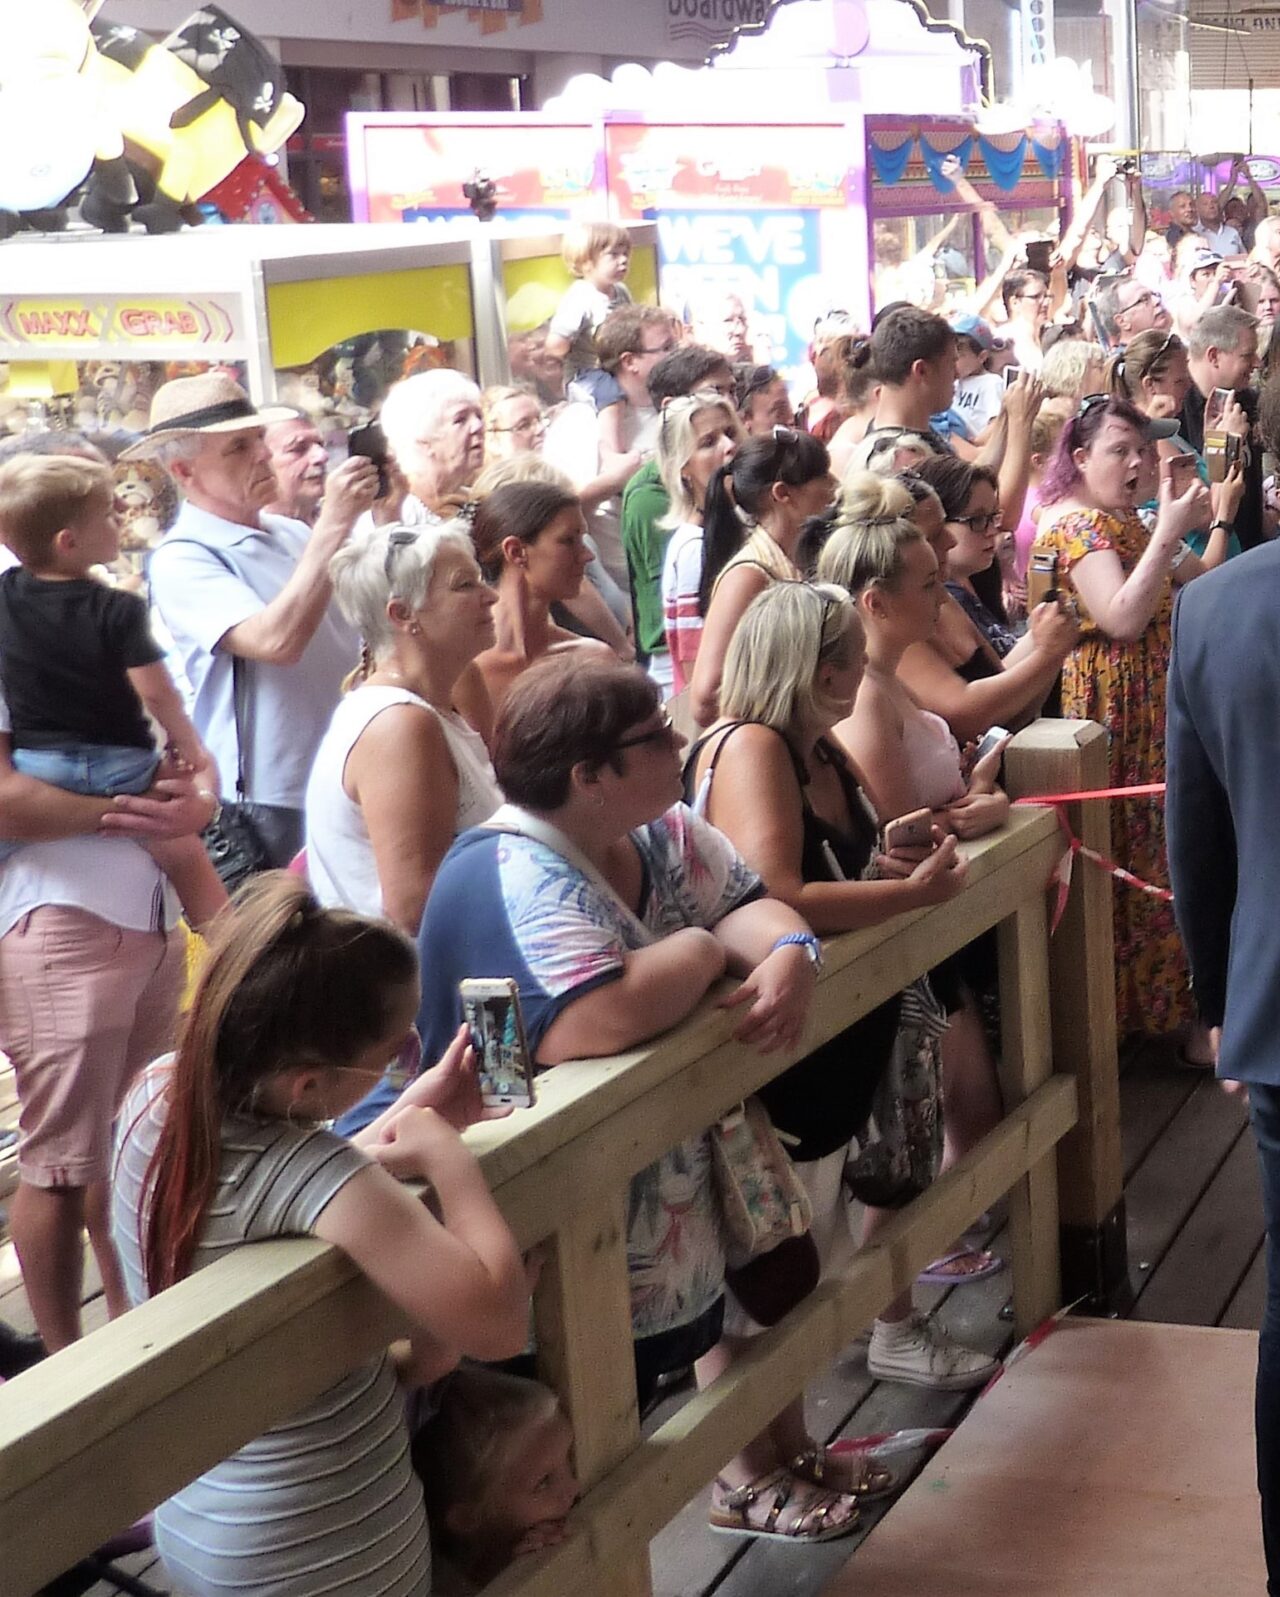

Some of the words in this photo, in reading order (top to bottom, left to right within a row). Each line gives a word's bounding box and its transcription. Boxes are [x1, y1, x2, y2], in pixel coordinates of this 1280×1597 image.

[656, 214, 806, 264] WE'VE
[19, 310, 99, 337] MAXX
[119, 308, 199, 337] GRAB
